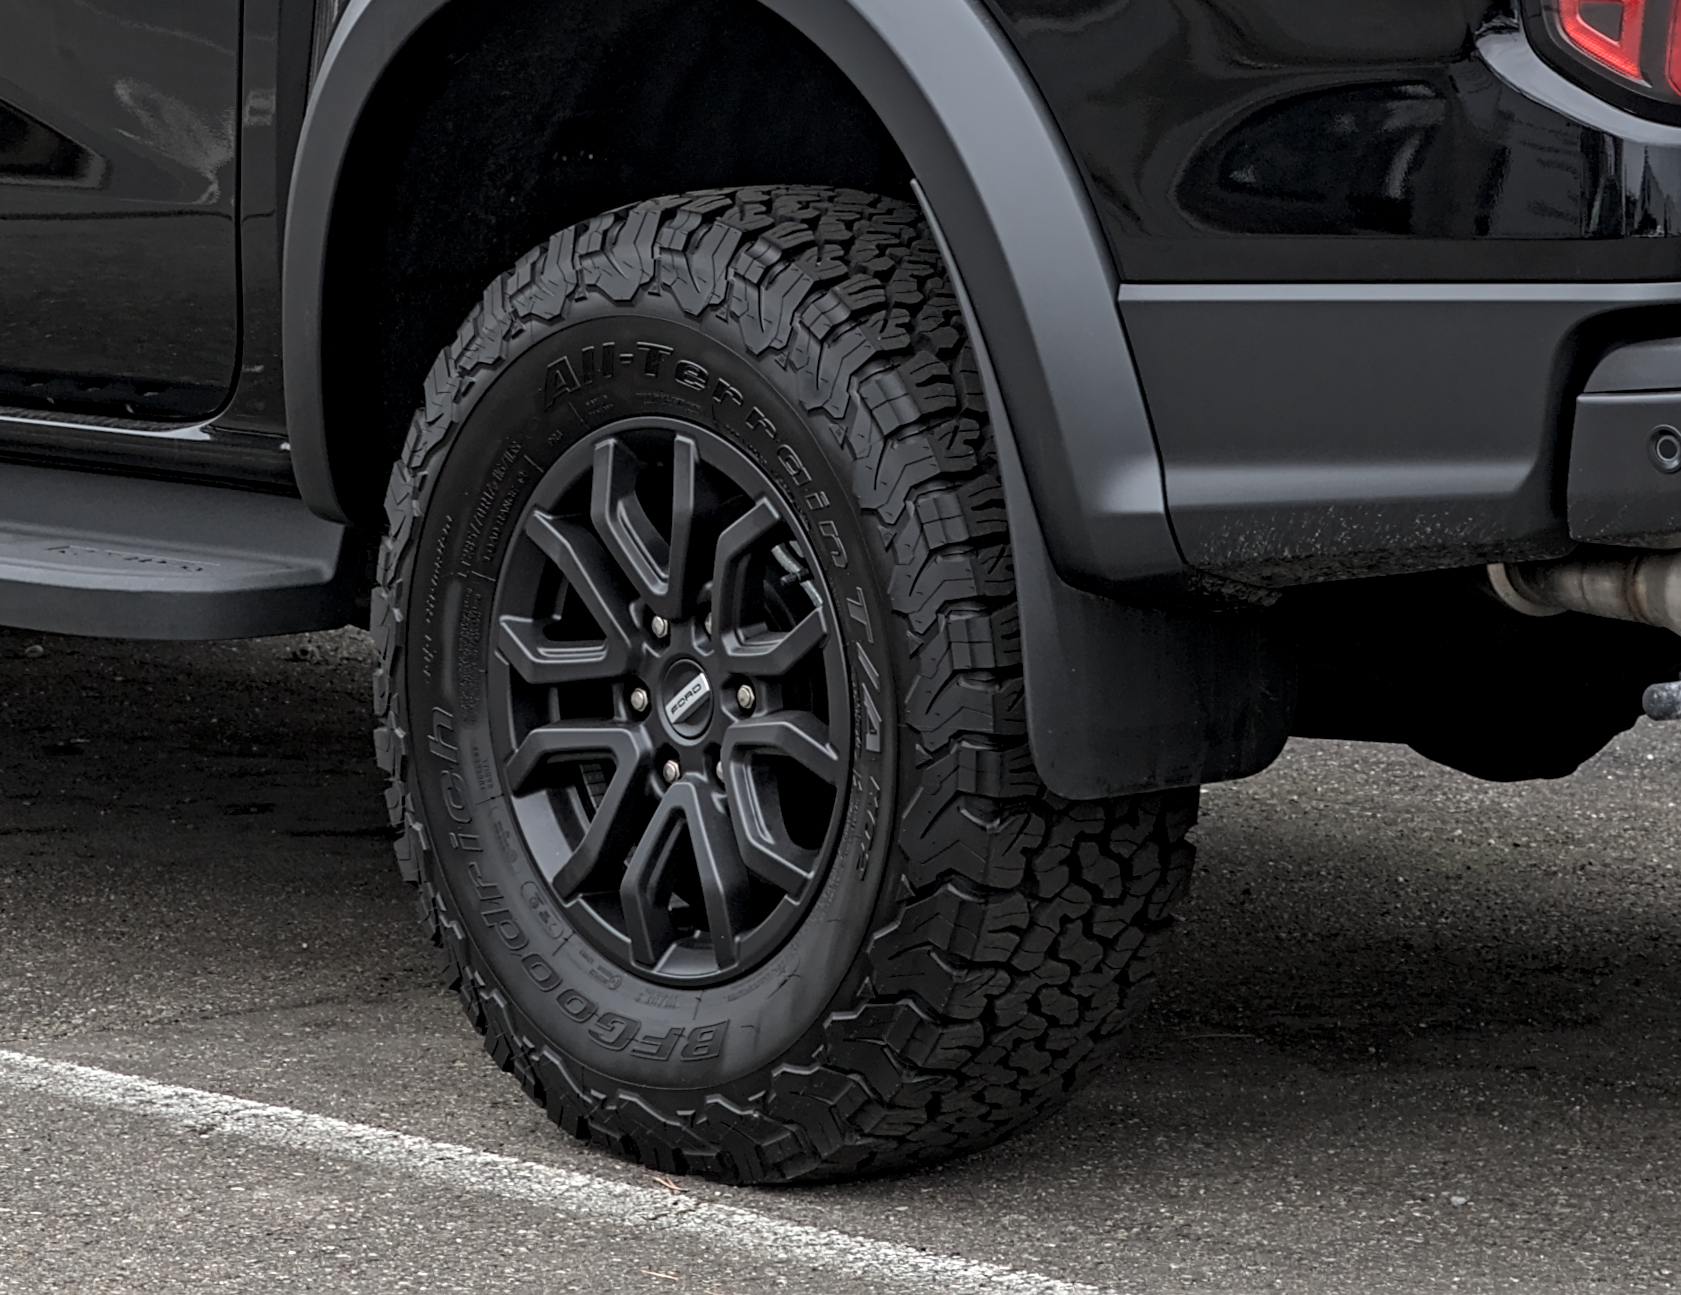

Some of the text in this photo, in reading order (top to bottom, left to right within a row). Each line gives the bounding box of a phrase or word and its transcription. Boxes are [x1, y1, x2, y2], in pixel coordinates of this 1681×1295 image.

[545, 340, 848, 571] All-Terrain
[670, 683, 703, 715] FORD
[429, 705, 730, 1063] BFGoodrich
